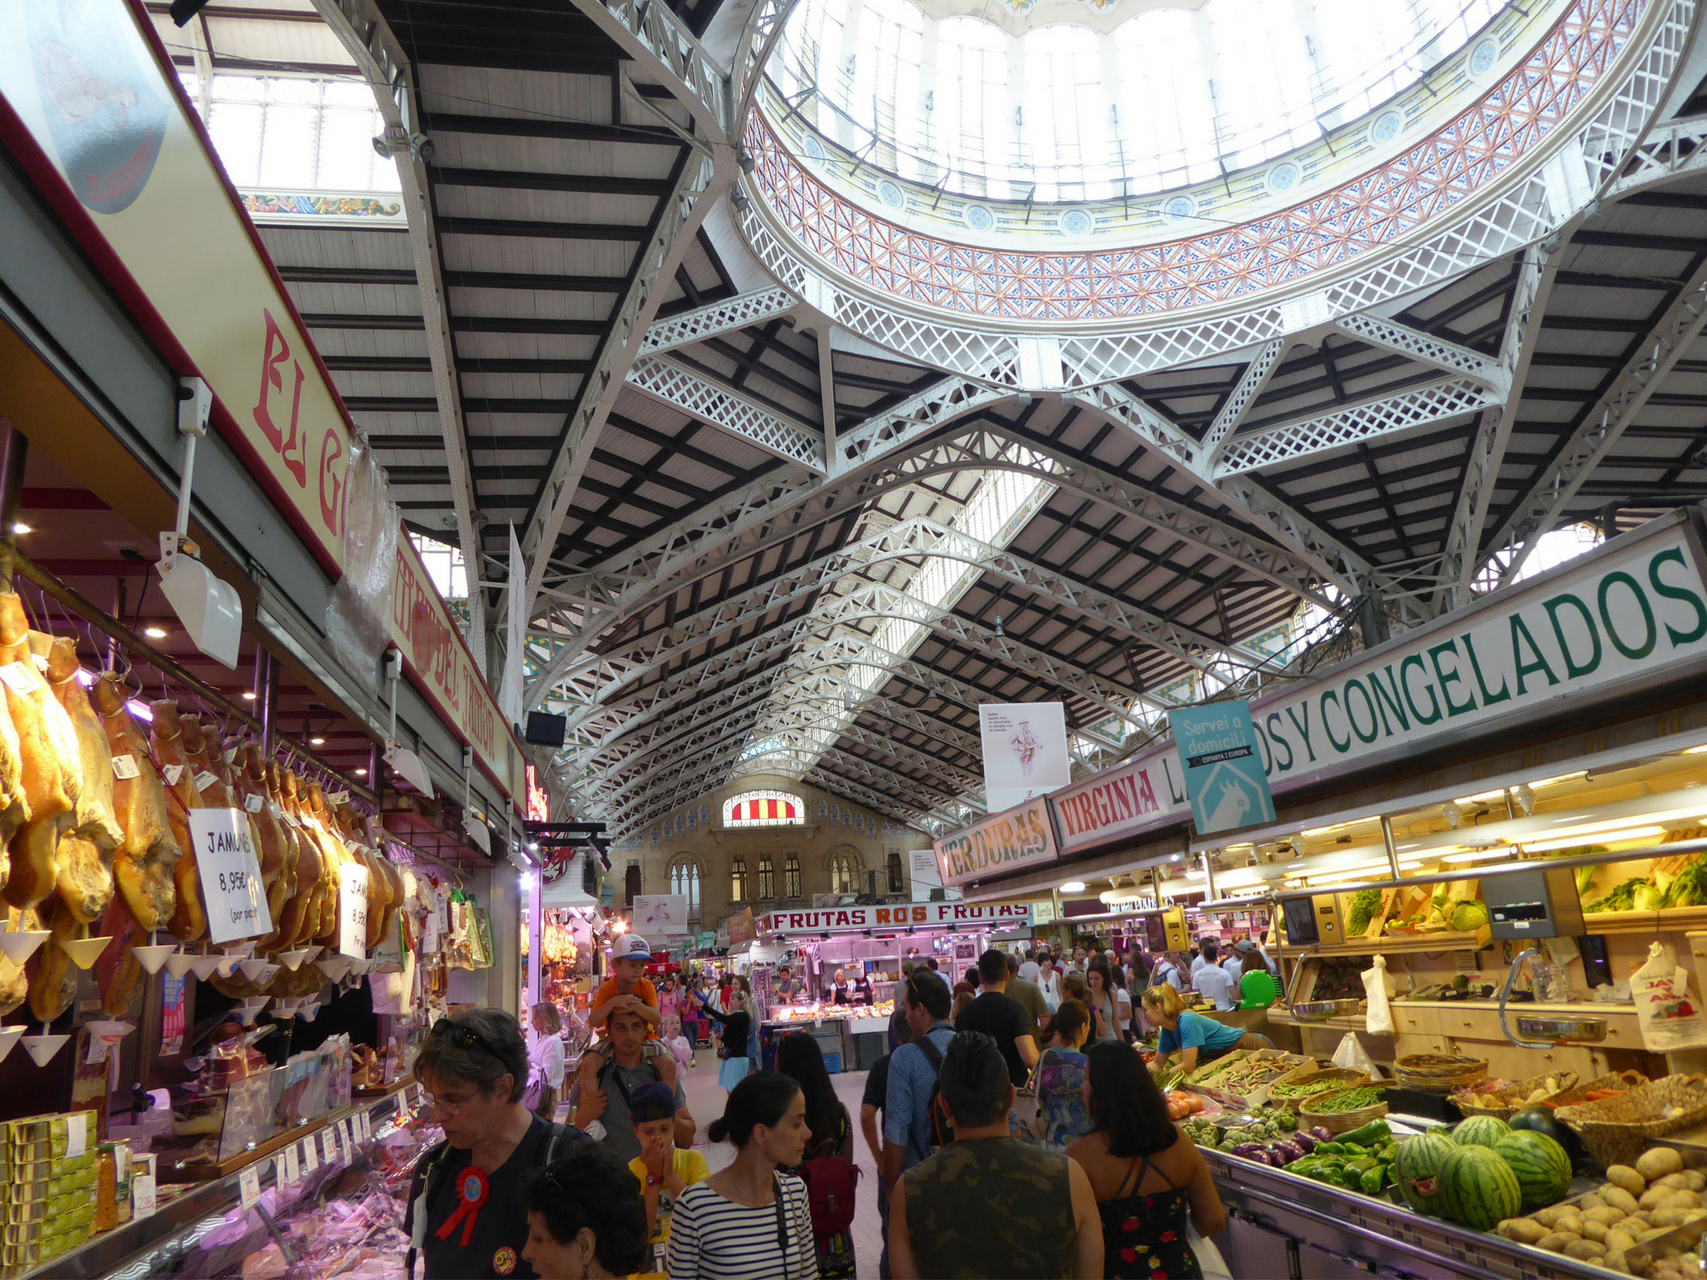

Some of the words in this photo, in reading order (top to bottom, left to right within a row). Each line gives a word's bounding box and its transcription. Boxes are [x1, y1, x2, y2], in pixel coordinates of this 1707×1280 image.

[253, 307, 307, 489] EL
[1320, 545, 1707, 754] CONGELADOS
[1183, 715, 1229, 736] Servei
[1232, 717, 1242, 729] a
[1188, 731, 1247, 755] domicili
[1202, 755, 1223, 764] ESPANYA
[1228, 749, 1249, 758] EUROPA
[1058, 768, 1160, 836] VIRGINIA
[773, 910, 866, 929] FRUTAS
[876, 906, 927, 925] ROS
